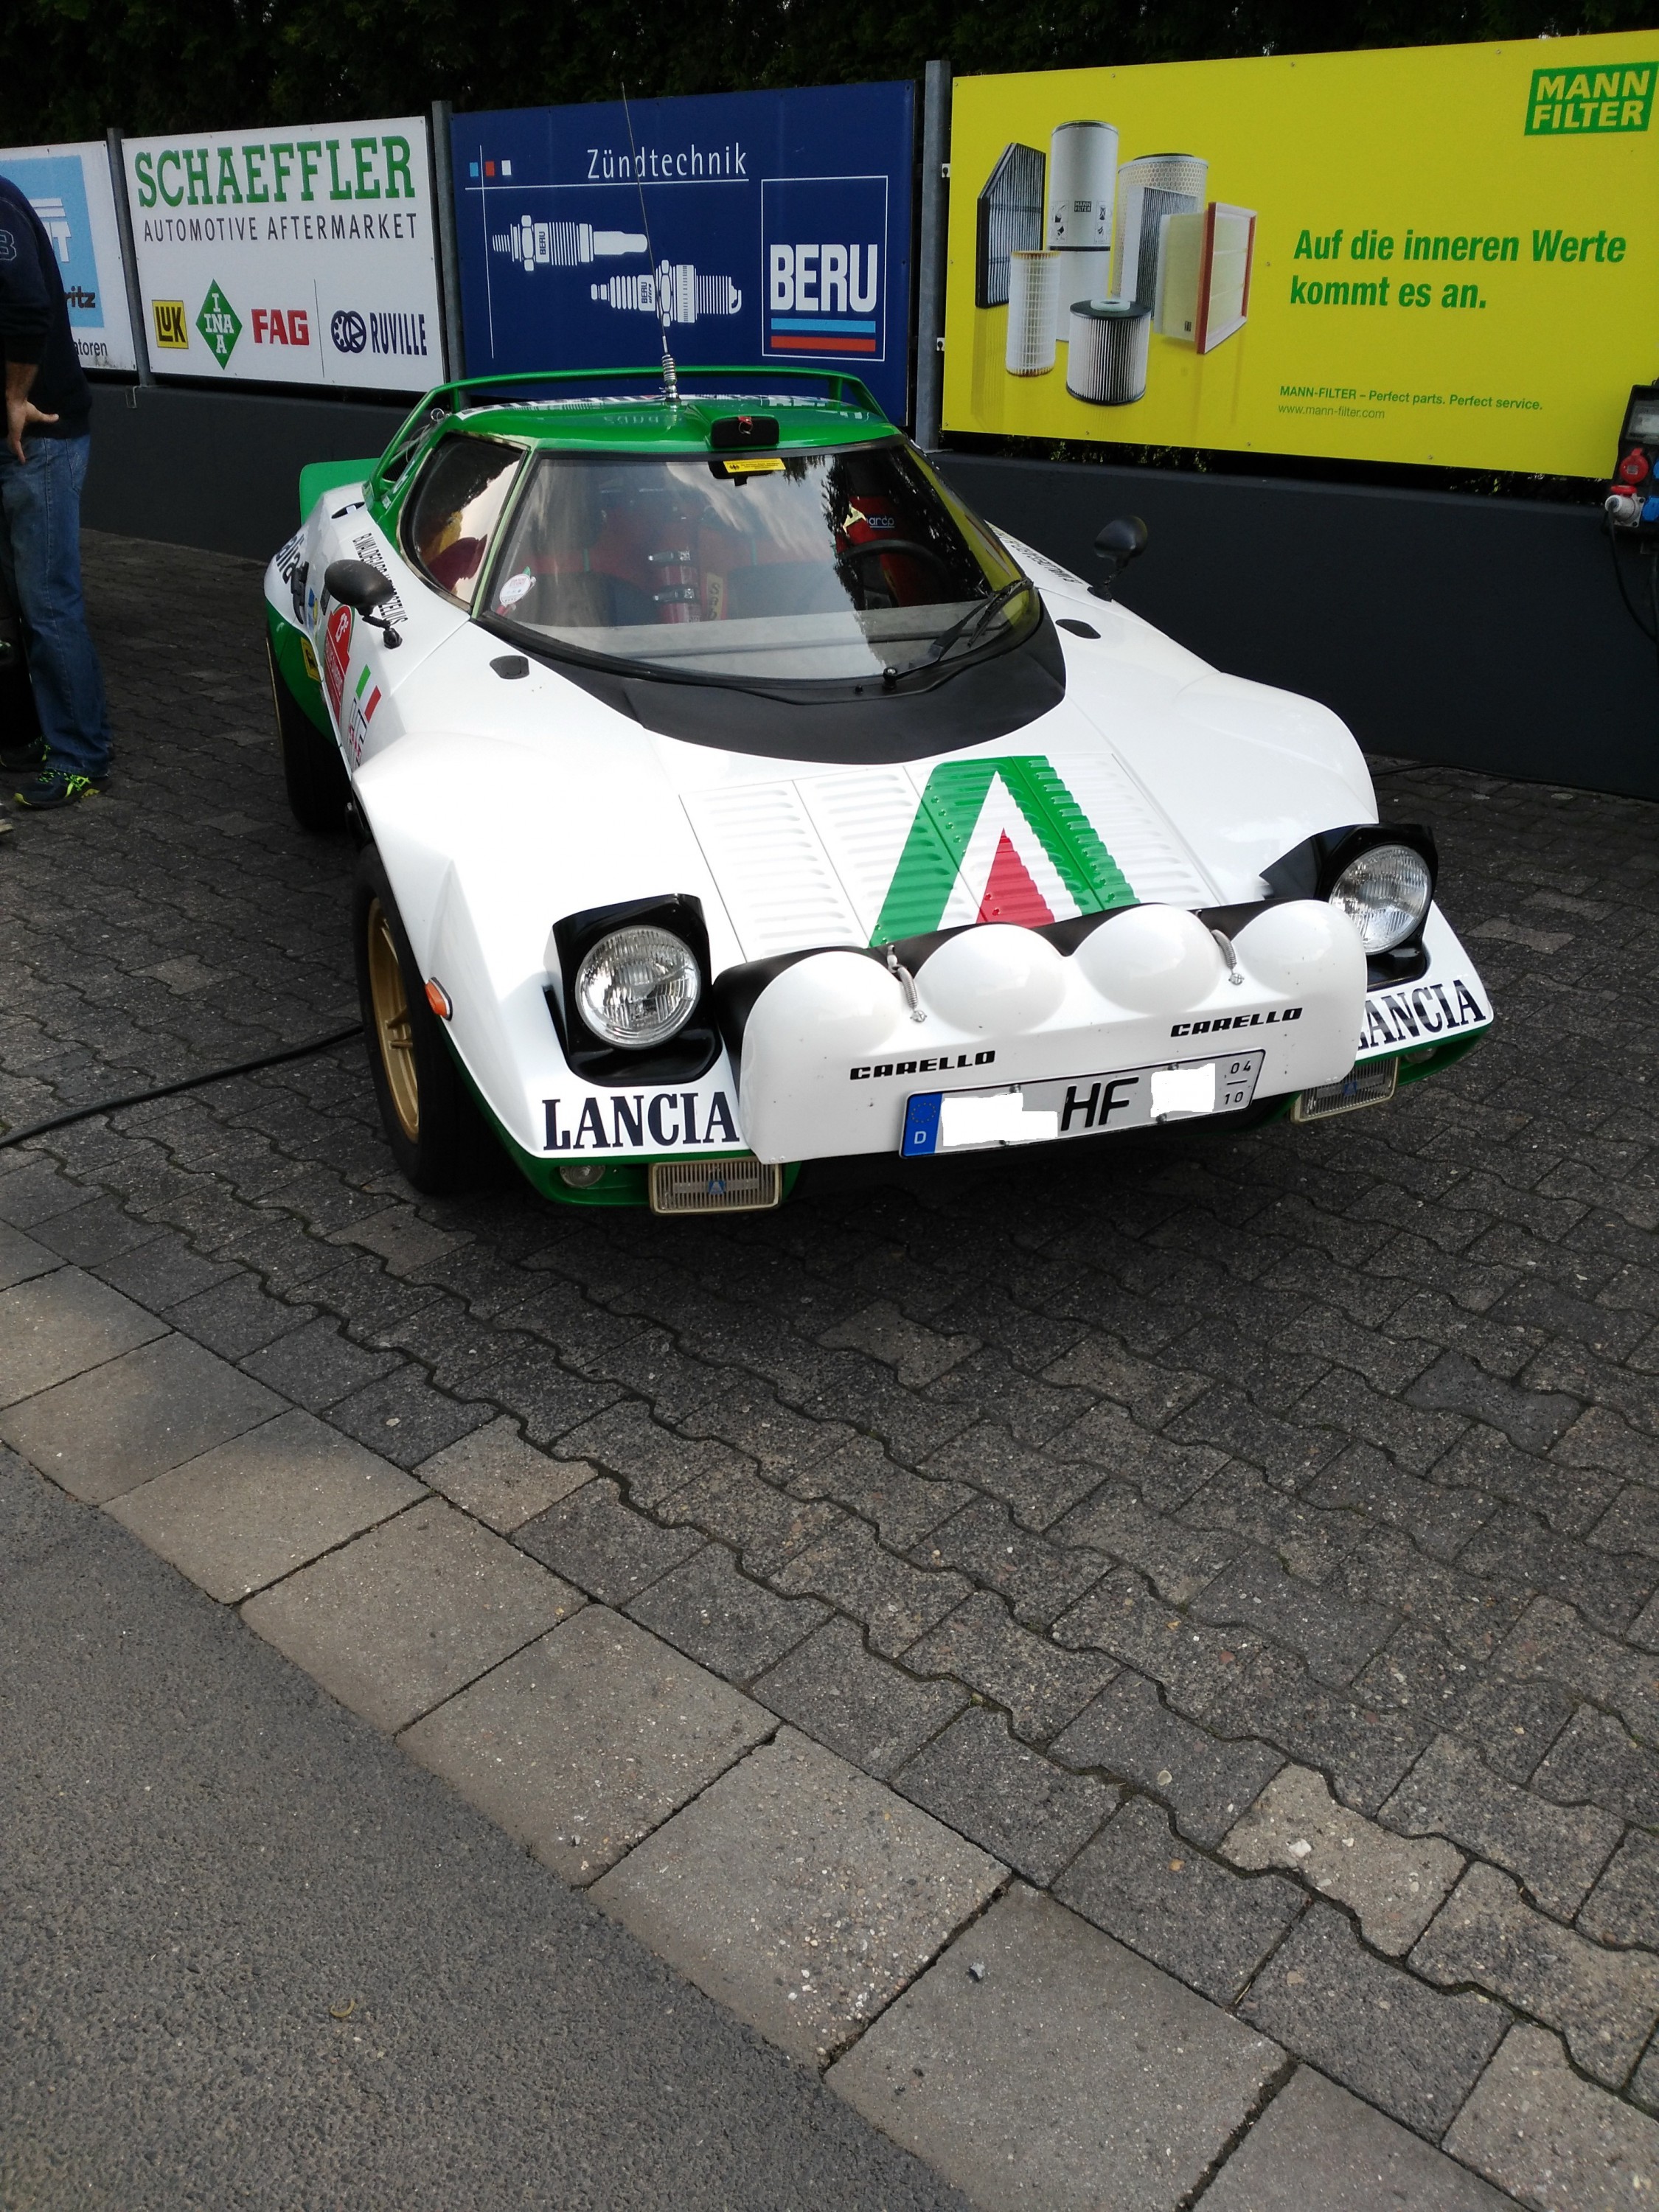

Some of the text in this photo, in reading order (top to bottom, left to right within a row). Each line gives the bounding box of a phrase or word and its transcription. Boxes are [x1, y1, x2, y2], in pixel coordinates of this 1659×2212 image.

[1536, 70, 1651, 102] MANN
[1532, 100, 1644, 130] FILTER
[134, 135, 416, 207] SCHAEFFLER
[587, 142, 747, 179] Zündtechnik
[144, 213, 417, 242] AUTOMOTIVE AFTERMARKET
[538, 231, 546, 255] BERU
[1293, 229, 1627, 262] Auf die inneren Werte
[769, 244, 878, 312] BERU
[1290, 275, 1487, 308] kommt es an.
[251, 308, 310, 346] FAG
[369, 313, 427, 355] RUVILLE
[1278, 405, 1385, 419] www.mann-filter.com
[1280, 386, 1357, 400] MANN-FILTER
[1368, 390, 1410, 403] Perfect
[1413, 393, 1446, 406] parts.
[1450, 394, 1492, 408] Perfect
[1495, 397, 1543, 410] service.
[866, 516, 895, 526] arco
[1170, 1007, 1304, 1037] CARELLO
[1358, 979, 1486, 1051] ANCIA
[850, 1050, 995, 1080] CARELLO
[1231, 1060, 1252, 1074] 04
[1060, 1077, 1139, 1131] HF
[1224, 1091, 1244, 1105] 10
[541, 1091, 740, 1151] LANCIA
[914, 1131, 927, 1144] D
